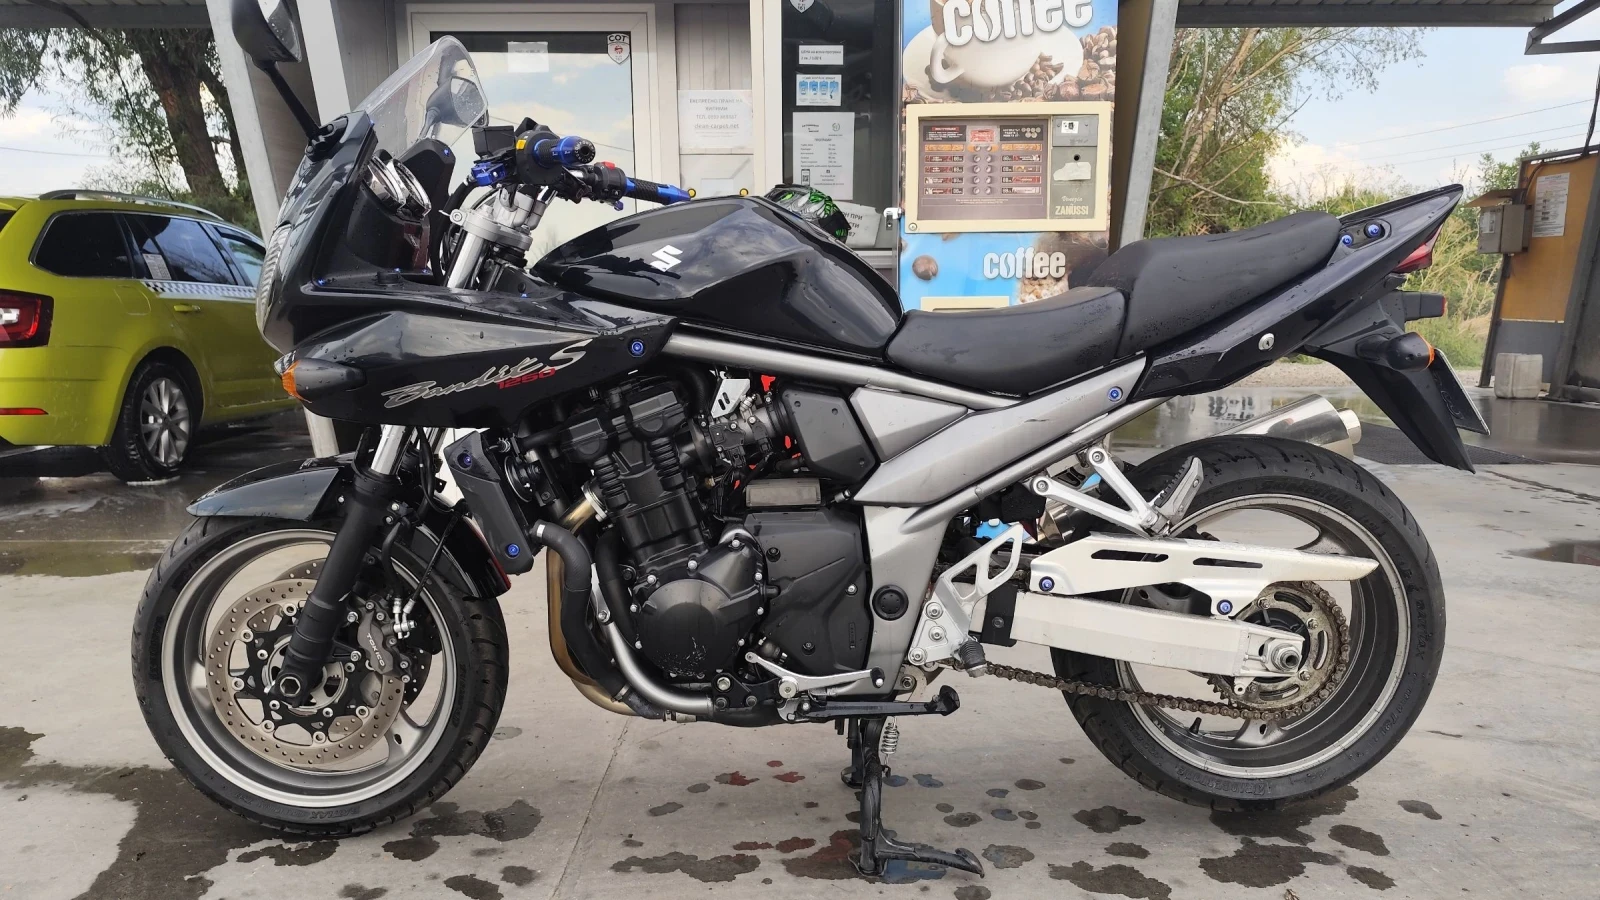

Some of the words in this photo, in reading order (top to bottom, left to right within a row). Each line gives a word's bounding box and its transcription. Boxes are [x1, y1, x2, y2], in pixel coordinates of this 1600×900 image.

[1055, 204, 1089, 216] ZANUSSI
[983, 246, 1066, 279] coffee
[381, 357, 544, 408] Bandit
[497, 367, 556, 389] 1250
[366, 632, 385, 667] TOKICO
